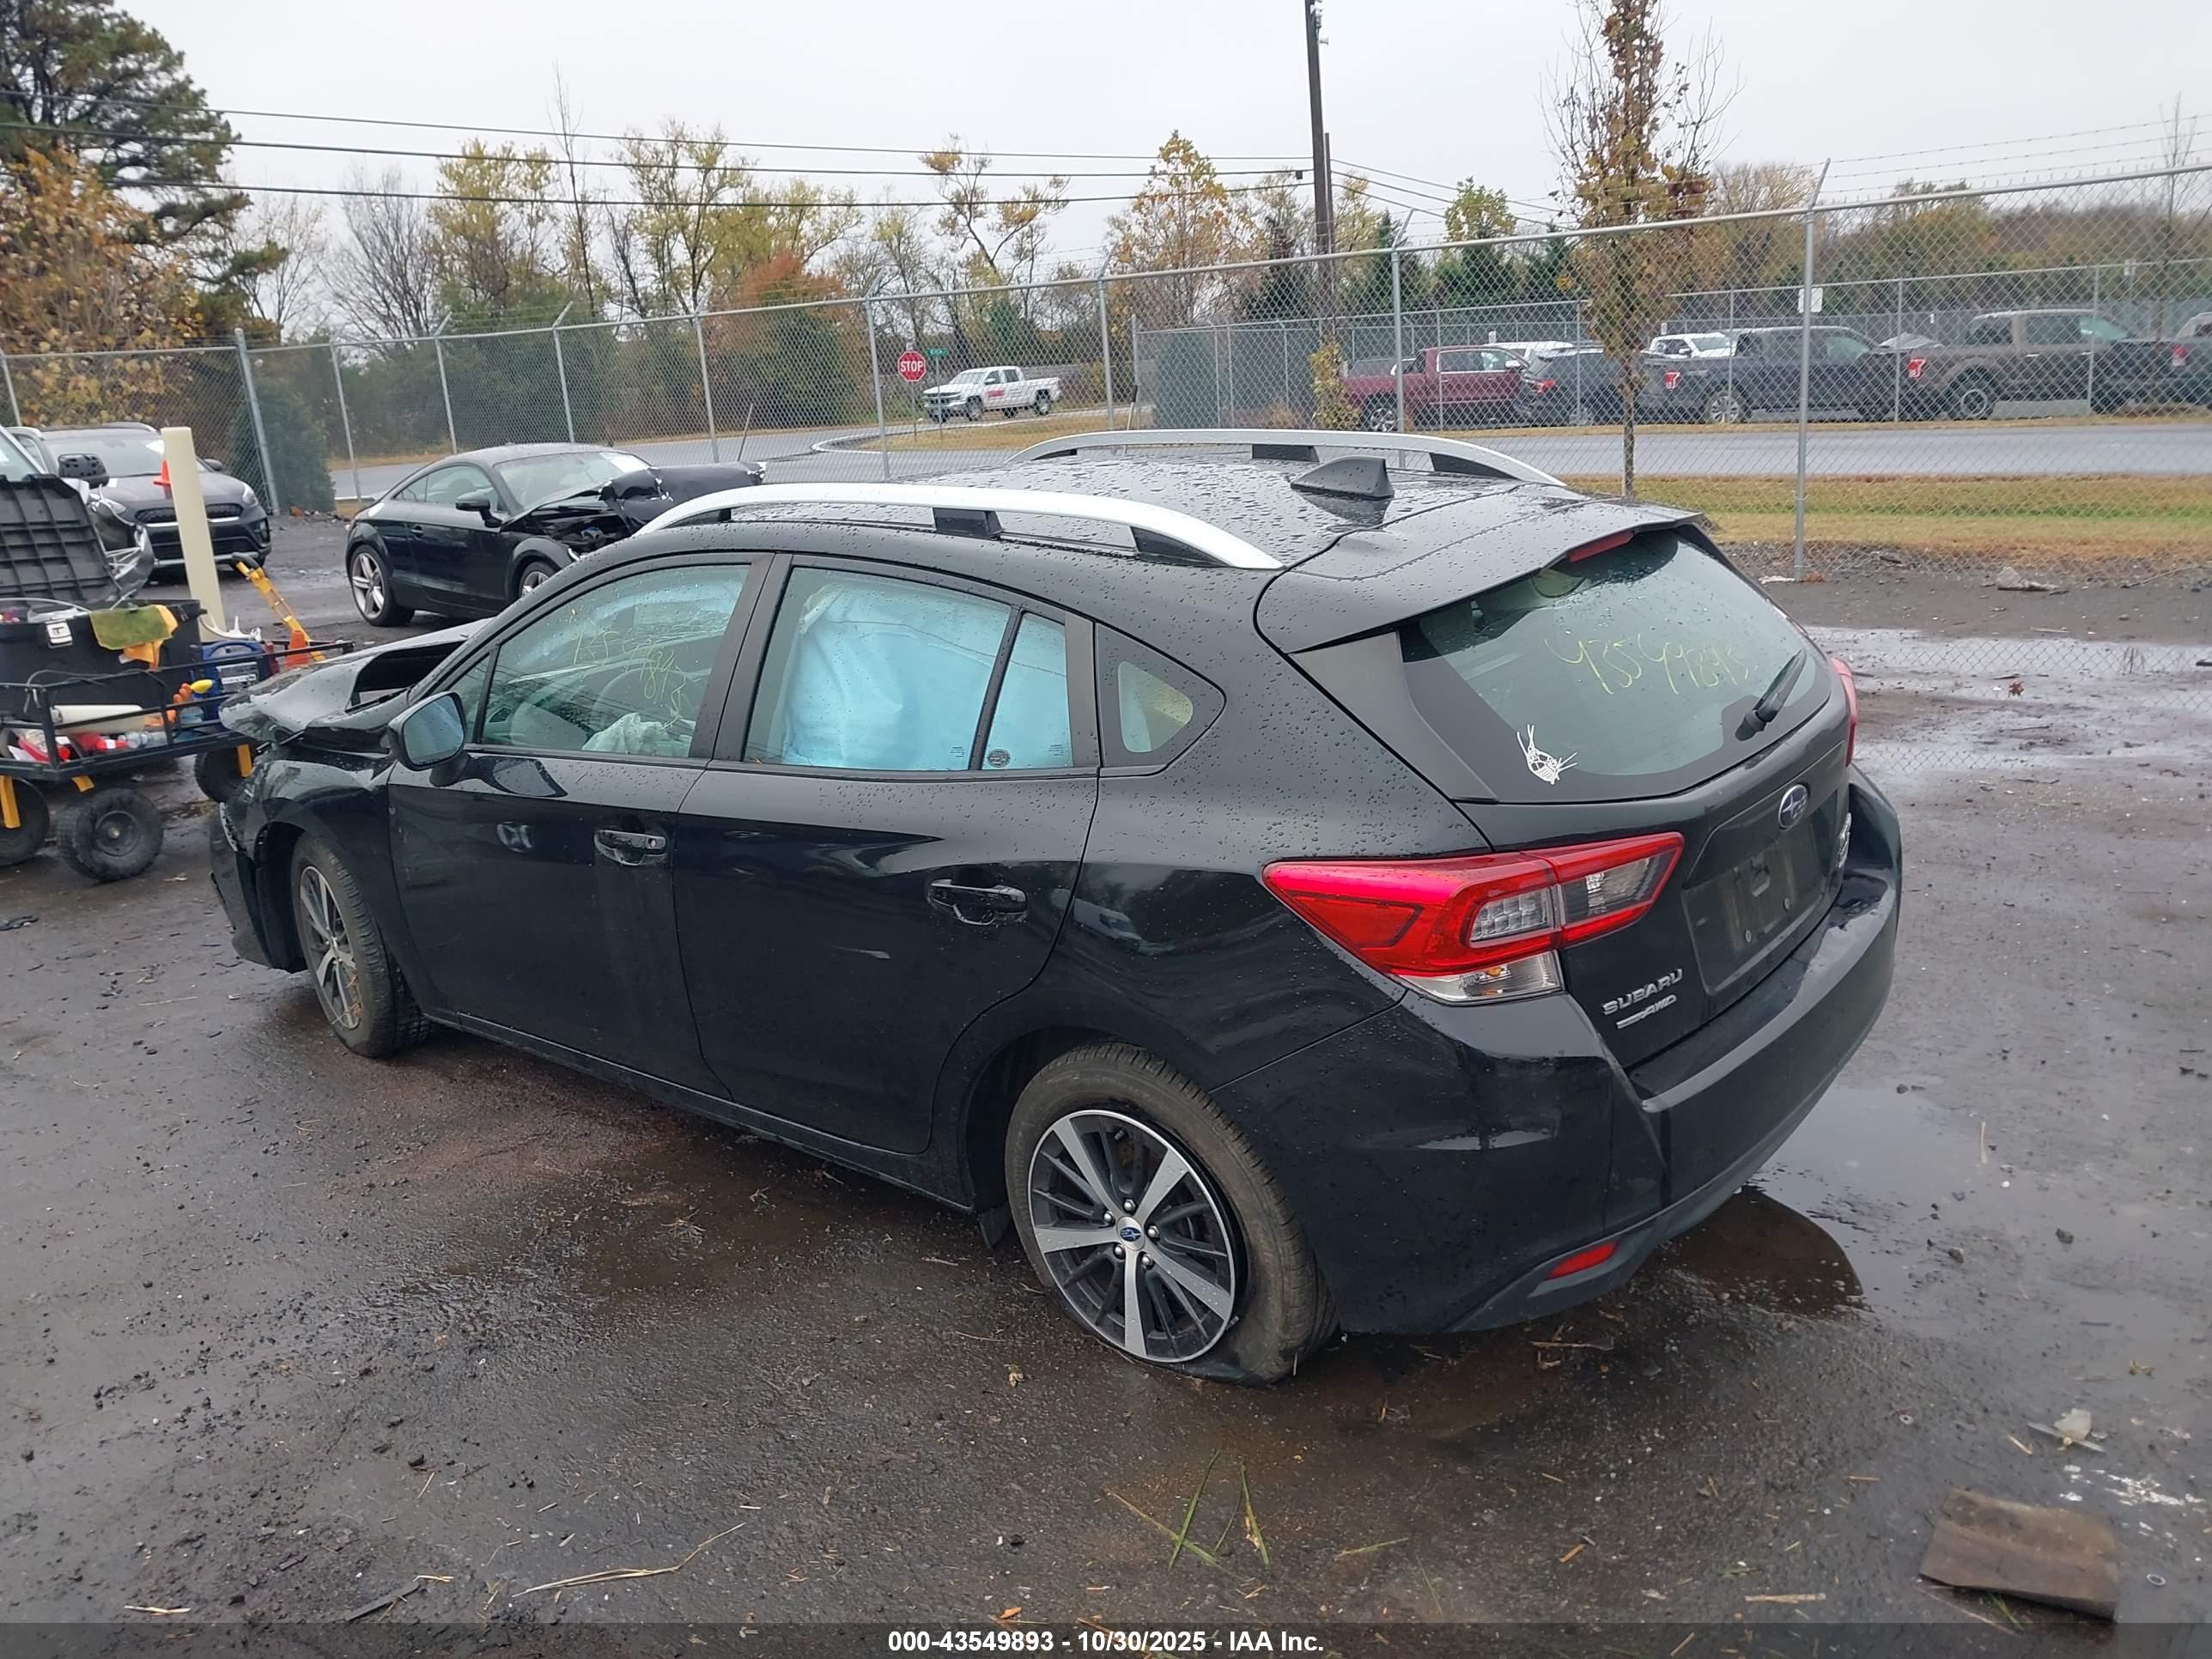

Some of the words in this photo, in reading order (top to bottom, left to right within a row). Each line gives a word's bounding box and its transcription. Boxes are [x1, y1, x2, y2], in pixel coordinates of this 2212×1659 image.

[900, 361, 924, 373] STOP
[1601, 968, 1683, 1016] SUBARU
[1642, 994, 1677, 1018] AWD
